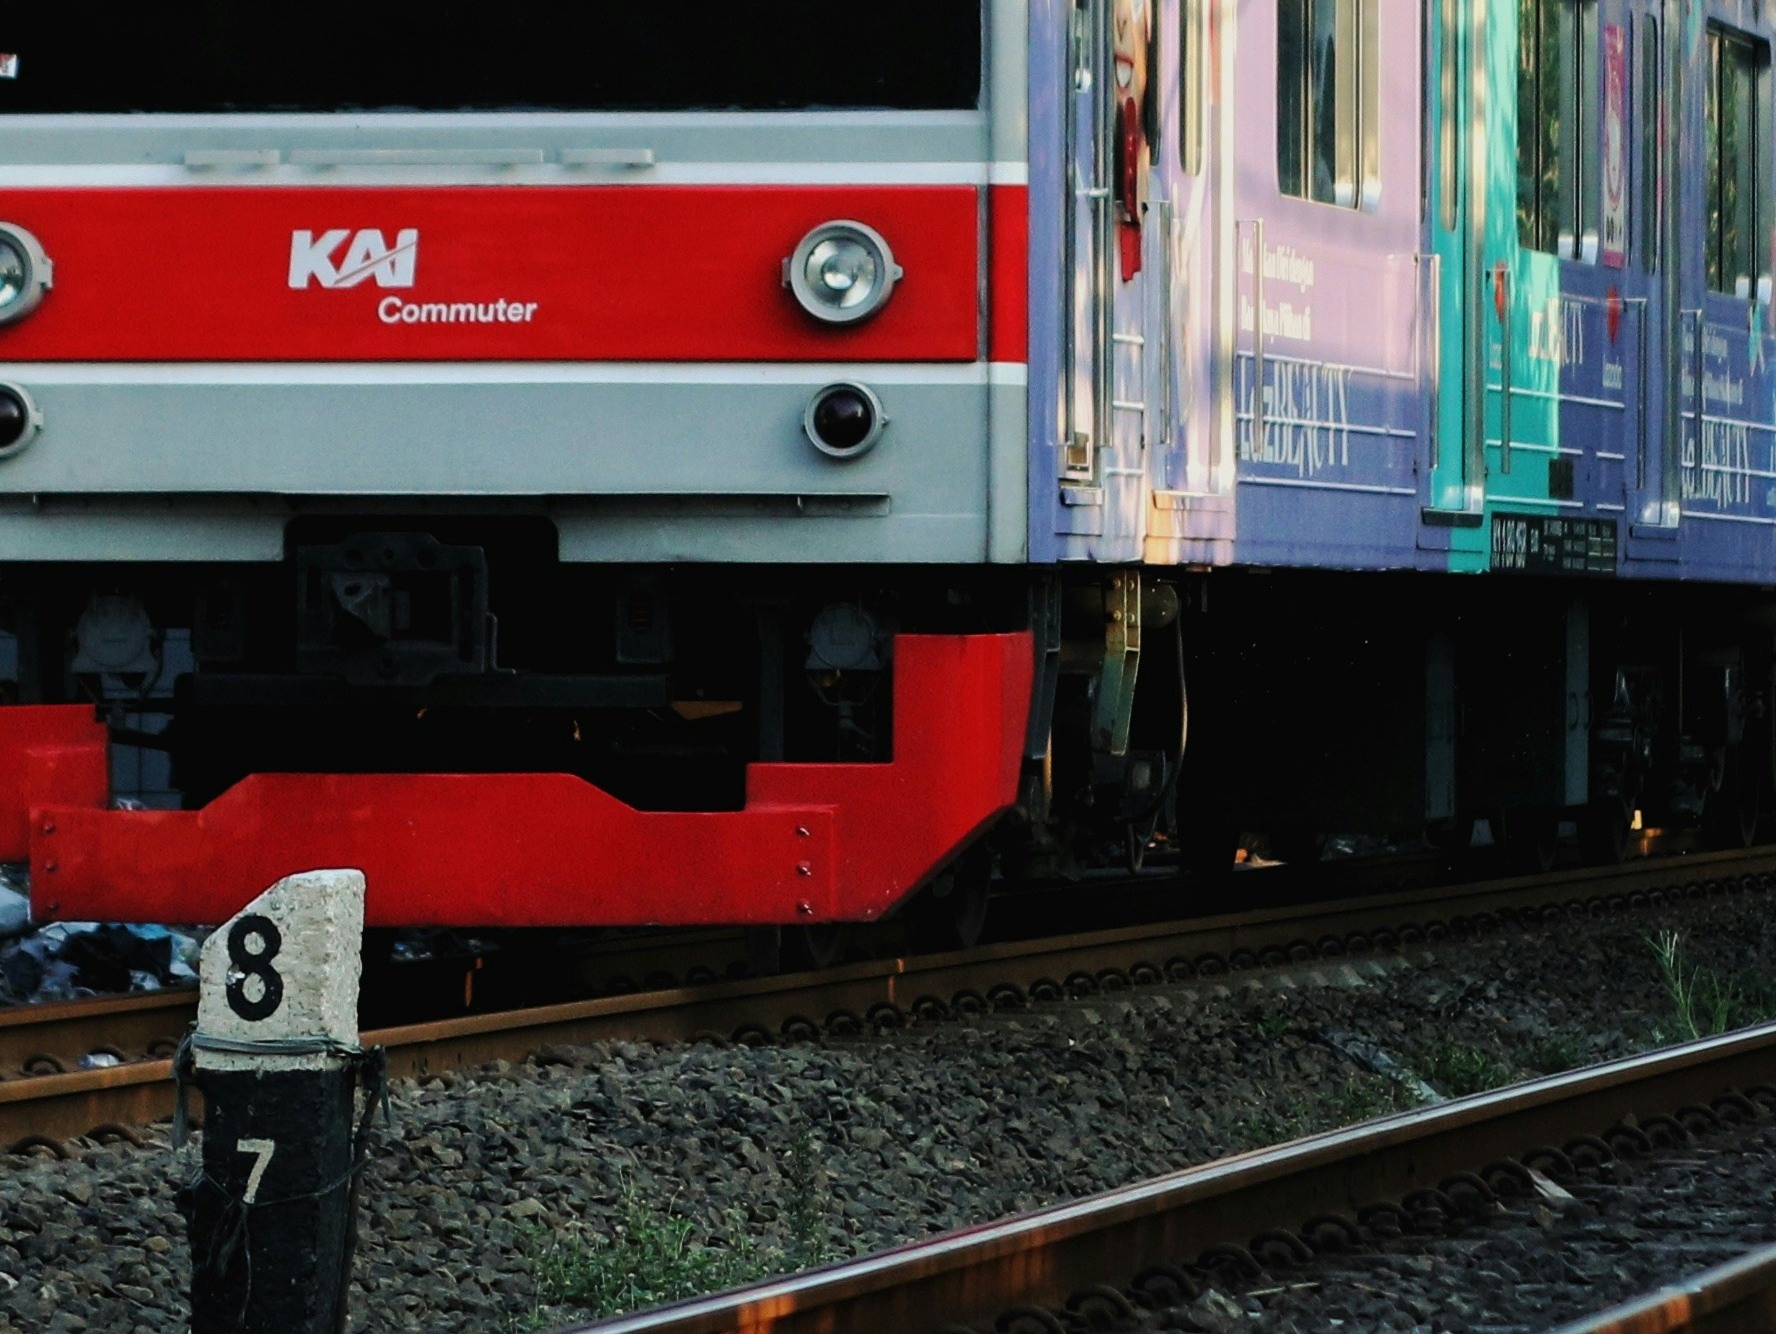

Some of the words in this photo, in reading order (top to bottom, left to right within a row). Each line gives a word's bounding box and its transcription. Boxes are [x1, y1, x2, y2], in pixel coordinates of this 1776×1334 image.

[288, 228, 419, 289] KAI
[377, 296, 538, 324] Commuter
[226, 913, 284, 1022] 8
[237, 1138, 274, 1204] 7
